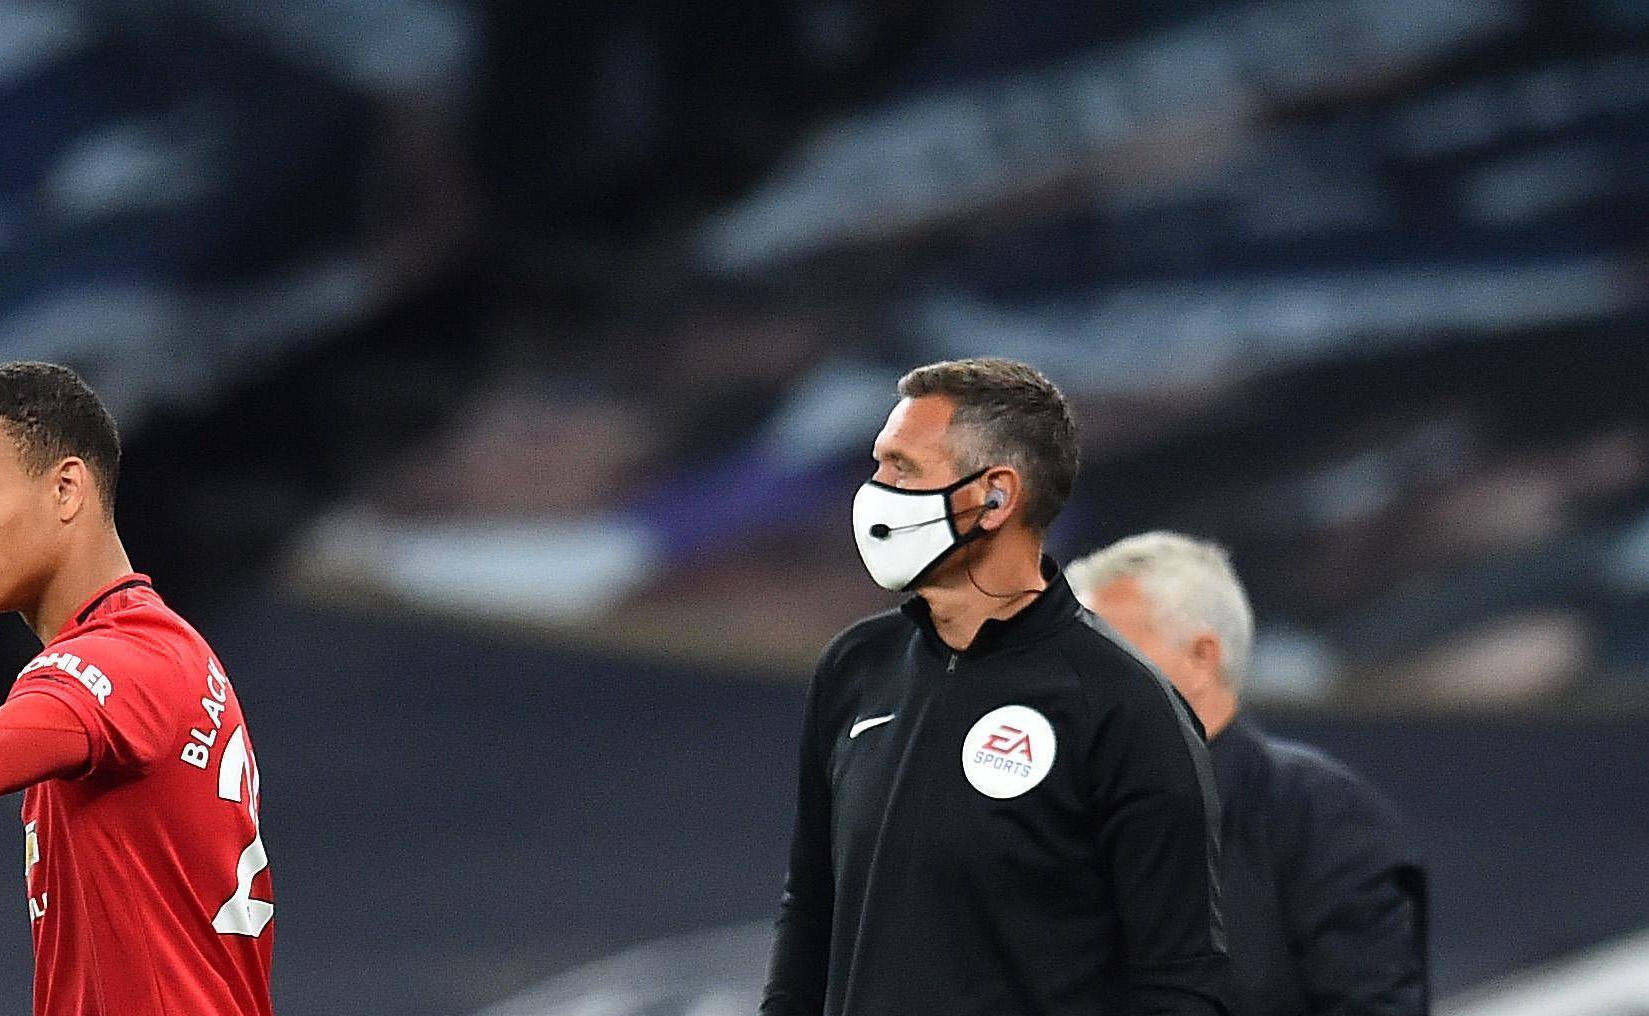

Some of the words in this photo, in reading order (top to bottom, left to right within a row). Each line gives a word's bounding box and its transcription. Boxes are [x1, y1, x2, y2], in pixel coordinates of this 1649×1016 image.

[17, 653, 113, 706] OHLER
[982, 724, 1033, 762] EA
[973, 751, 1031, 778] SPORTS
